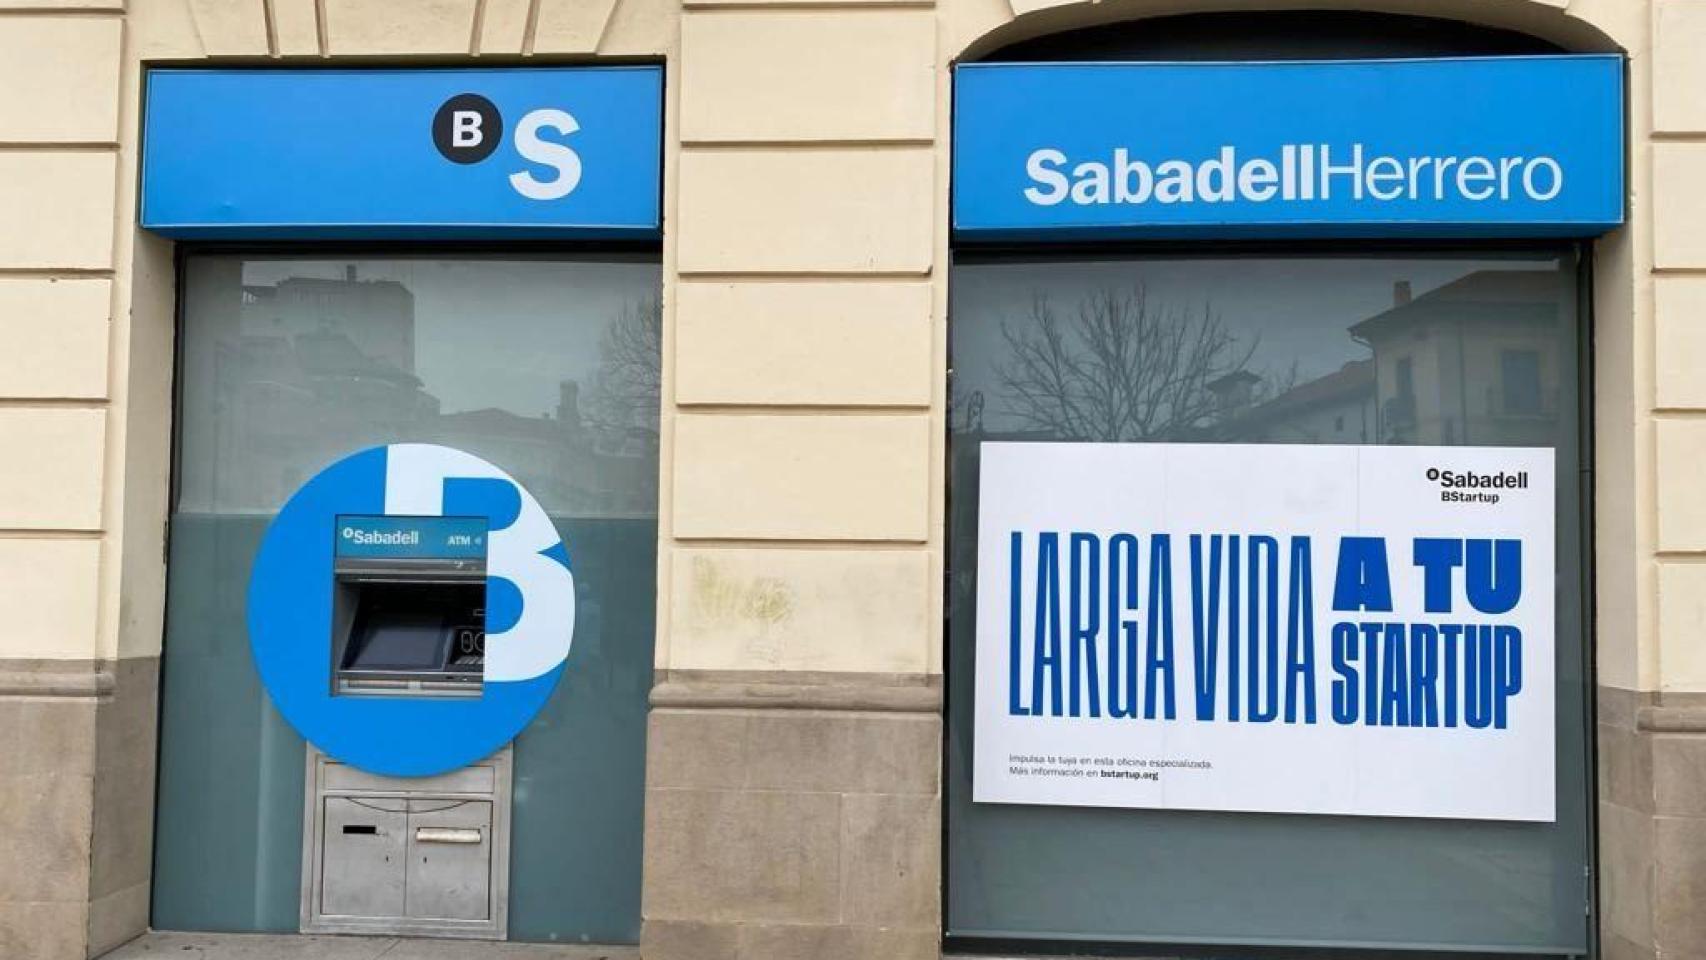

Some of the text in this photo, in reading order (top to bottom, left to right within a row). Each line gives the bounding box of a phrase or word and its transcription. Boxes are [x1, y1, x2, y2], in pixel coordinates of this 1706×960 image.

[453, 109, 582, 200] B S
[1024, 144, 1562, 206] SabadellHerrero
[1440, 471, 1529, 489] Sabadell
[1441, 491, 1500, 504] BStartup
[354, 530, 419, 545] Sabadell
[447, 535, 471, 546] ATM
[1332, 536, 1522, 615] A TU
[1009, 531, 1317, 725] LARGA VIDA
[1331, 621, 1522, 730] STARTUP
[1008, 752, 1045, 765] Impulsa
[1047, 755, 1056, 764] la
[1079, 758, 1092, 766] en
[1094, 757, 1114, 766] esta
[1117, 757, 1146, 767] oficina
[1009, 766, 1159, 781] Más información en bstartup.org
